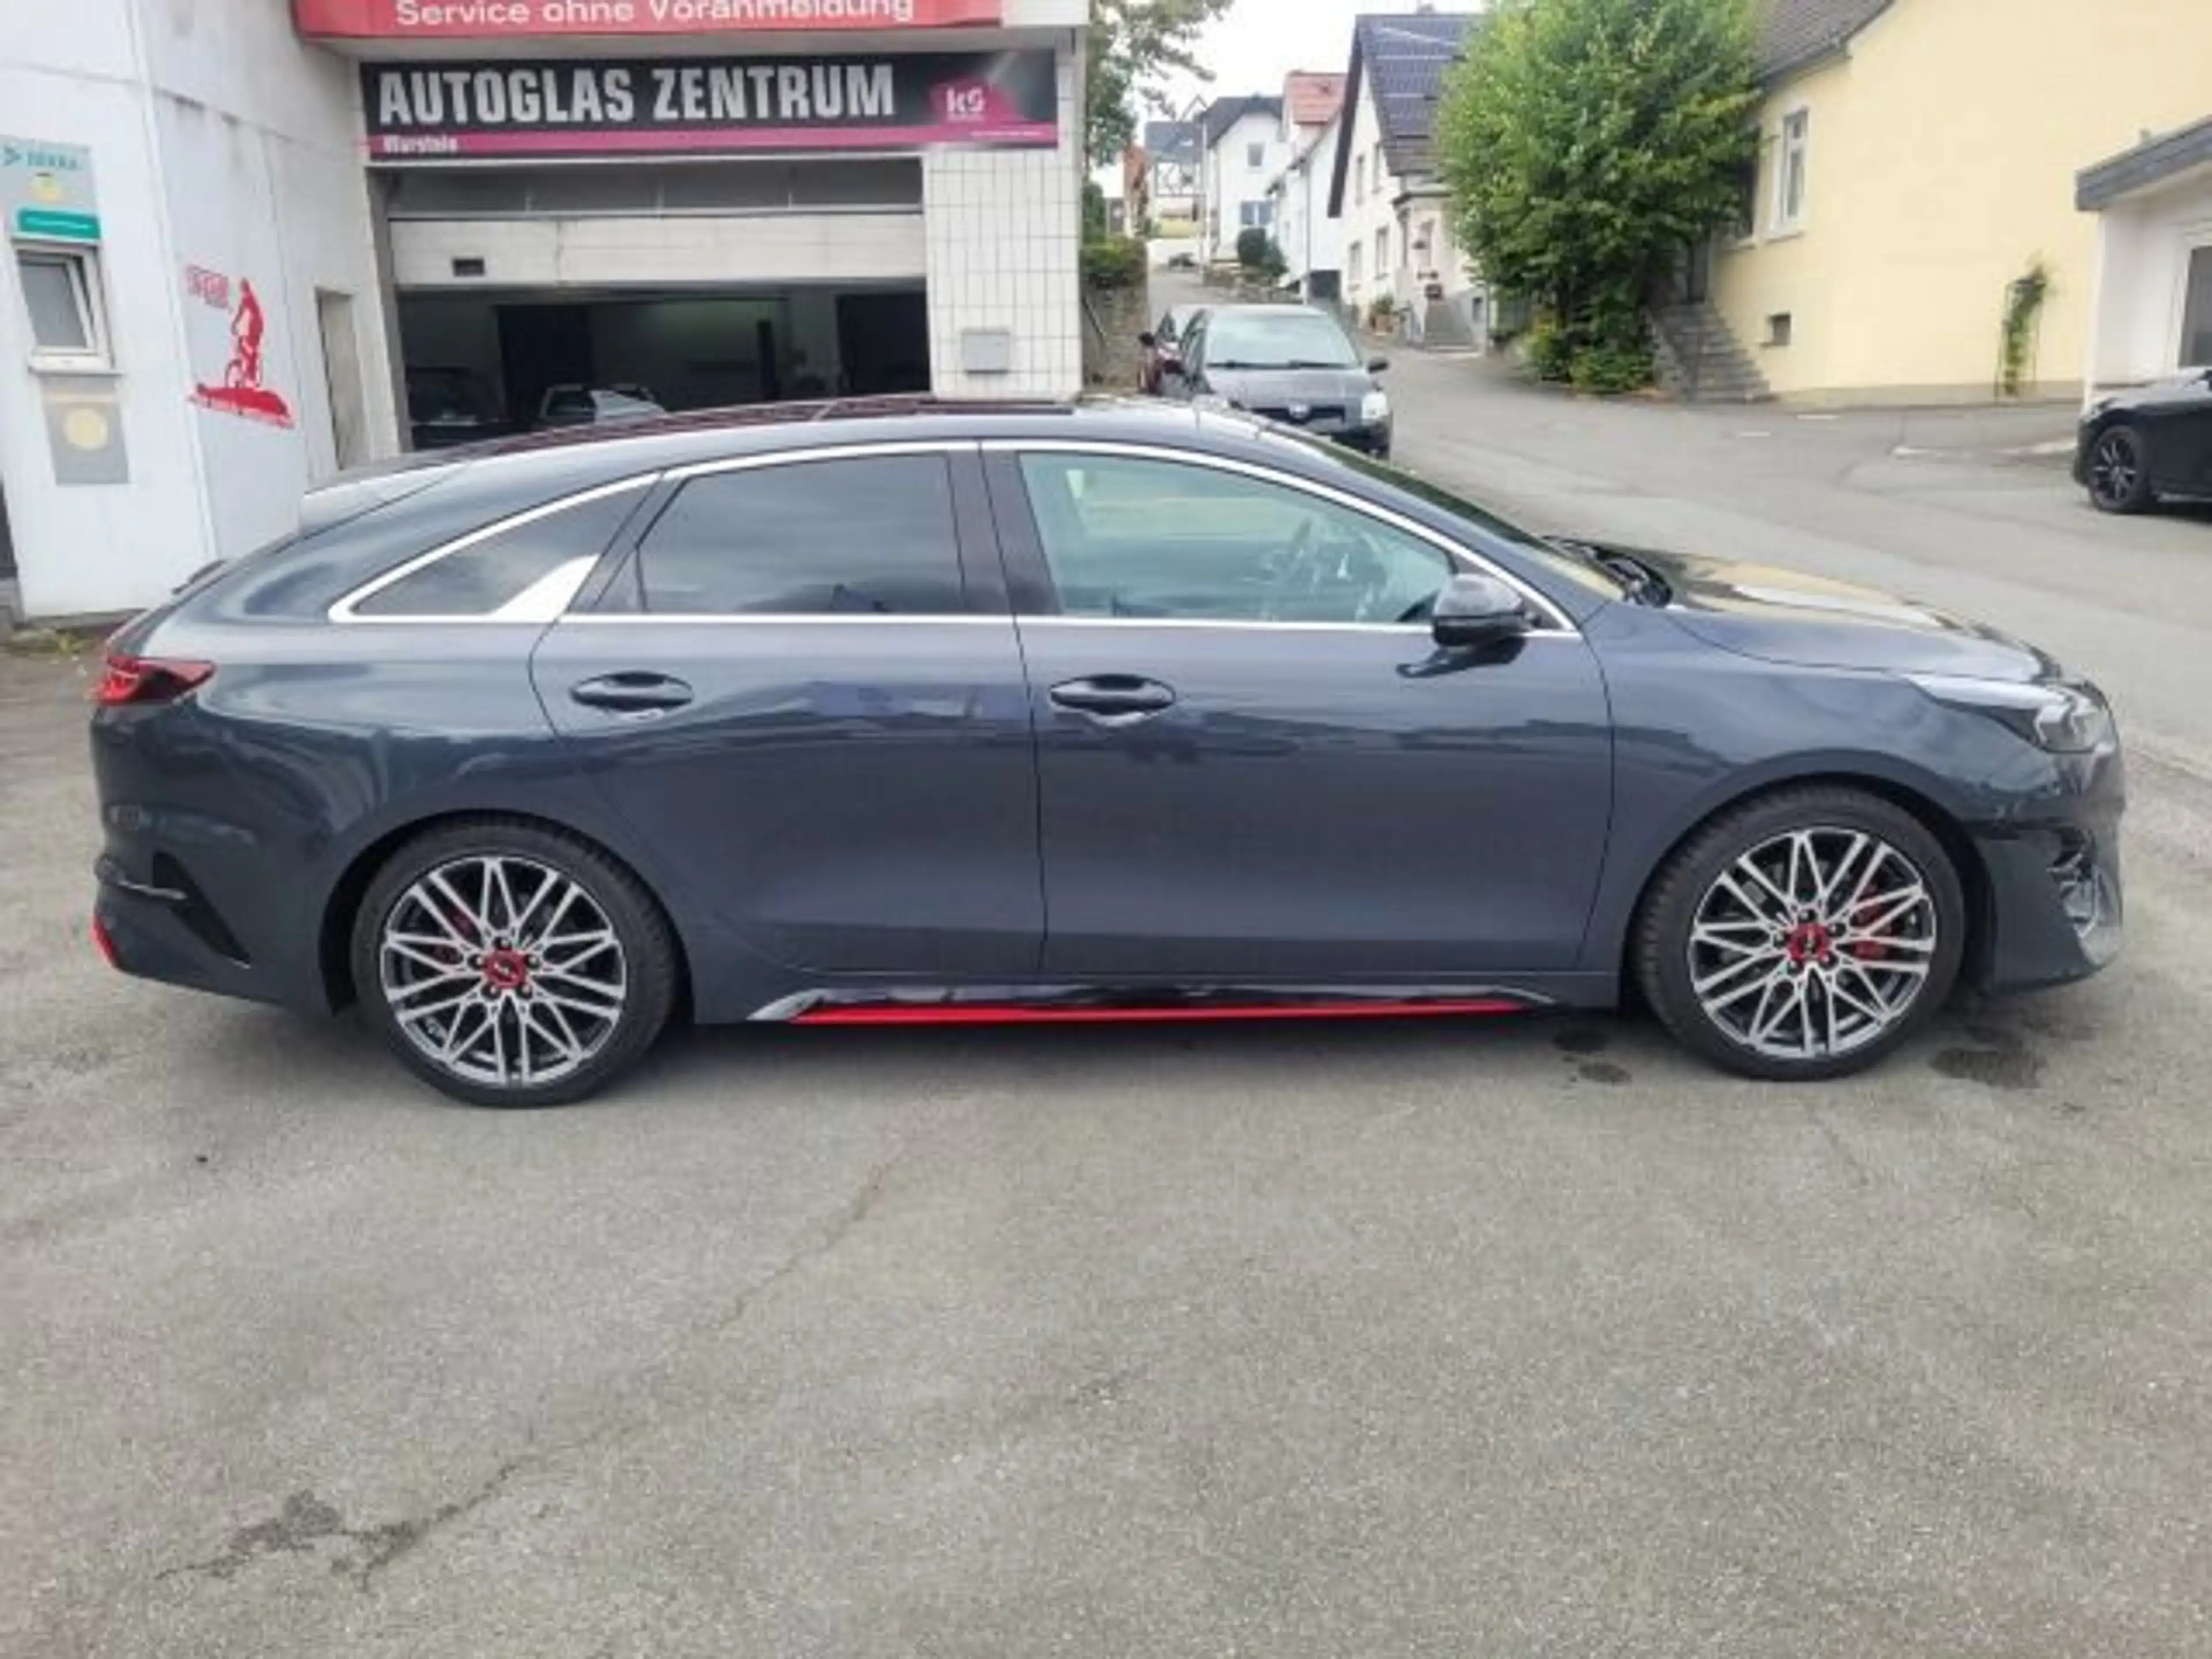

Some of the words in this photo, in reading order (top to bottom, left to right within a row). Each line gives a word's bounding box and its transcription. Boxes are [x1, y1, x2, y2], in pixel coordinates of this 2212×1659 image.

[396, 0, 530, 25] Service
[541, 0, 634, 24] ohne
[649, 0, 914, 22] Voranmeldung
[378, 68, 634, 126] AUTOGLAS
[652, 63, 894, 122] ZENTRUM
